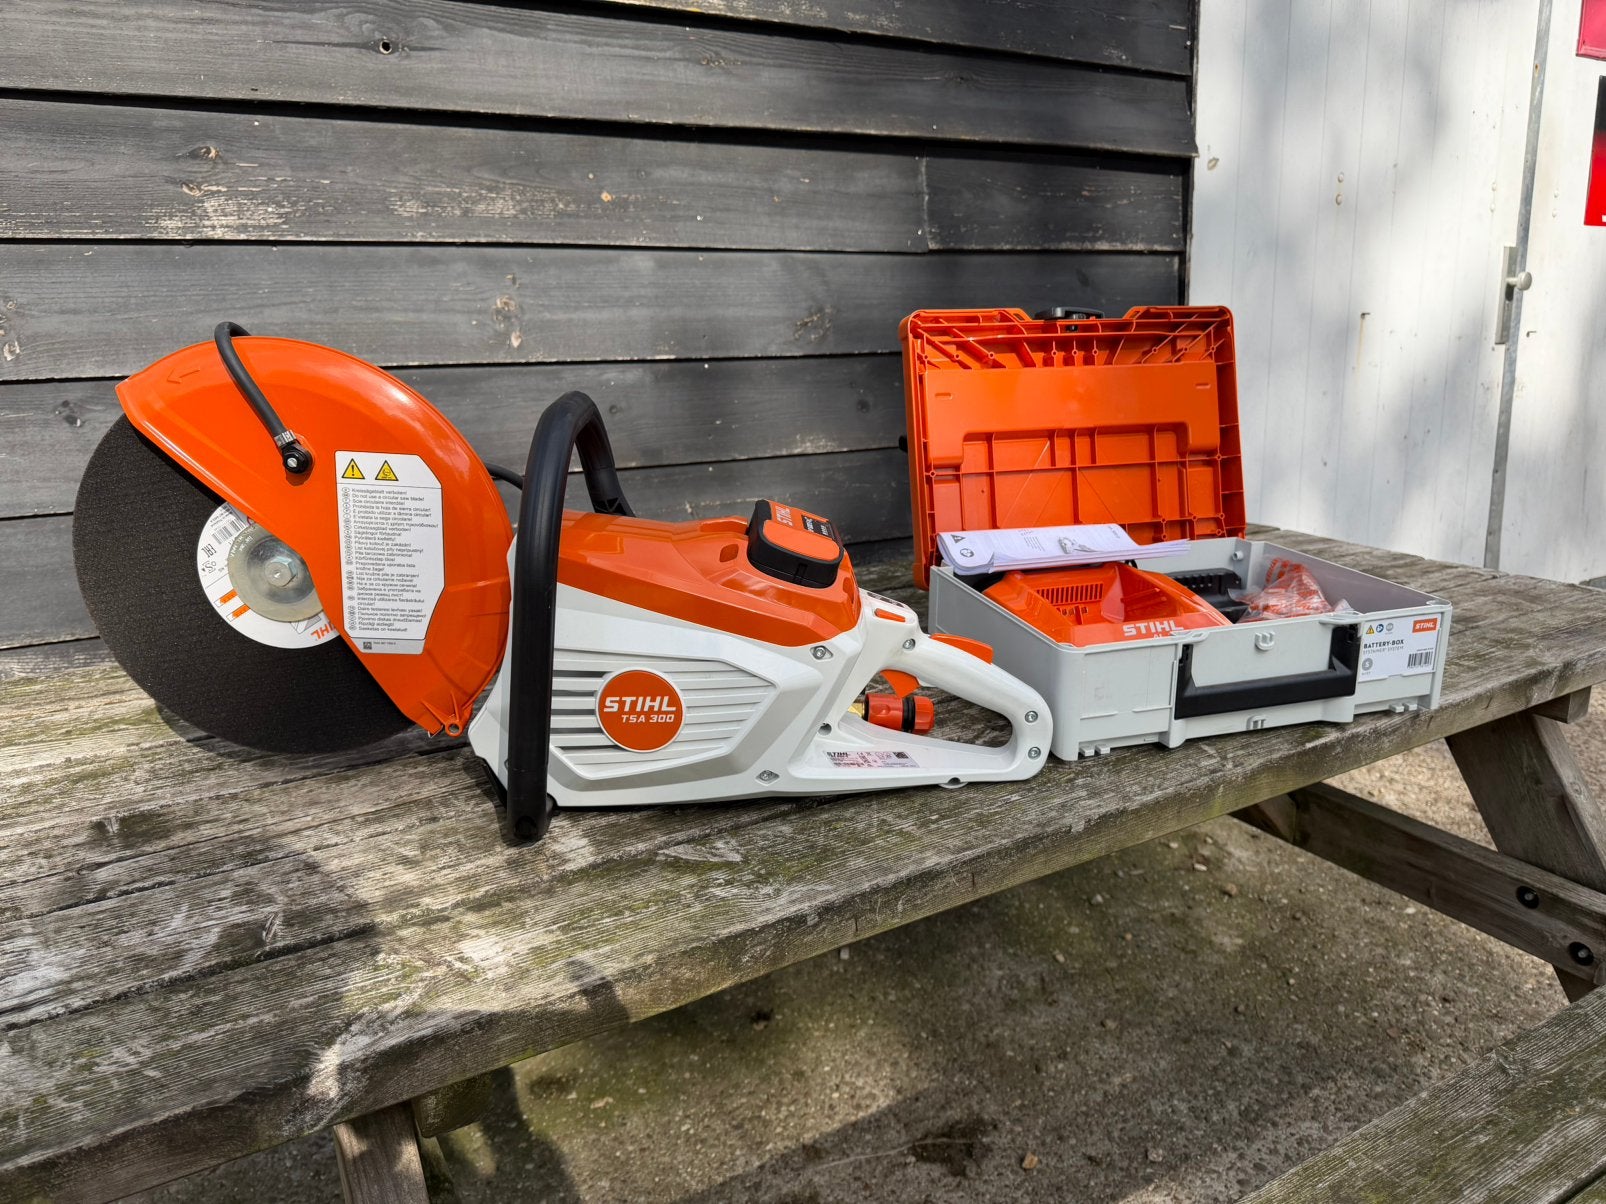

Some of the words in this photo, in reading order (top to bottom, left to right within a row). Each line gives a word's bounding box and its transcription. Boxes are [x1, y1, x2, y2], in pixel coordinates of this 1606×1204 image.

[1122, 620, 1184, 637] STIHL
[1414, 622, 1434, 630] STIHL
[604, 696, 676, 712] STIHL
[622, 715, 646, 723] TSA
[649, 714, 674, 723] 300
